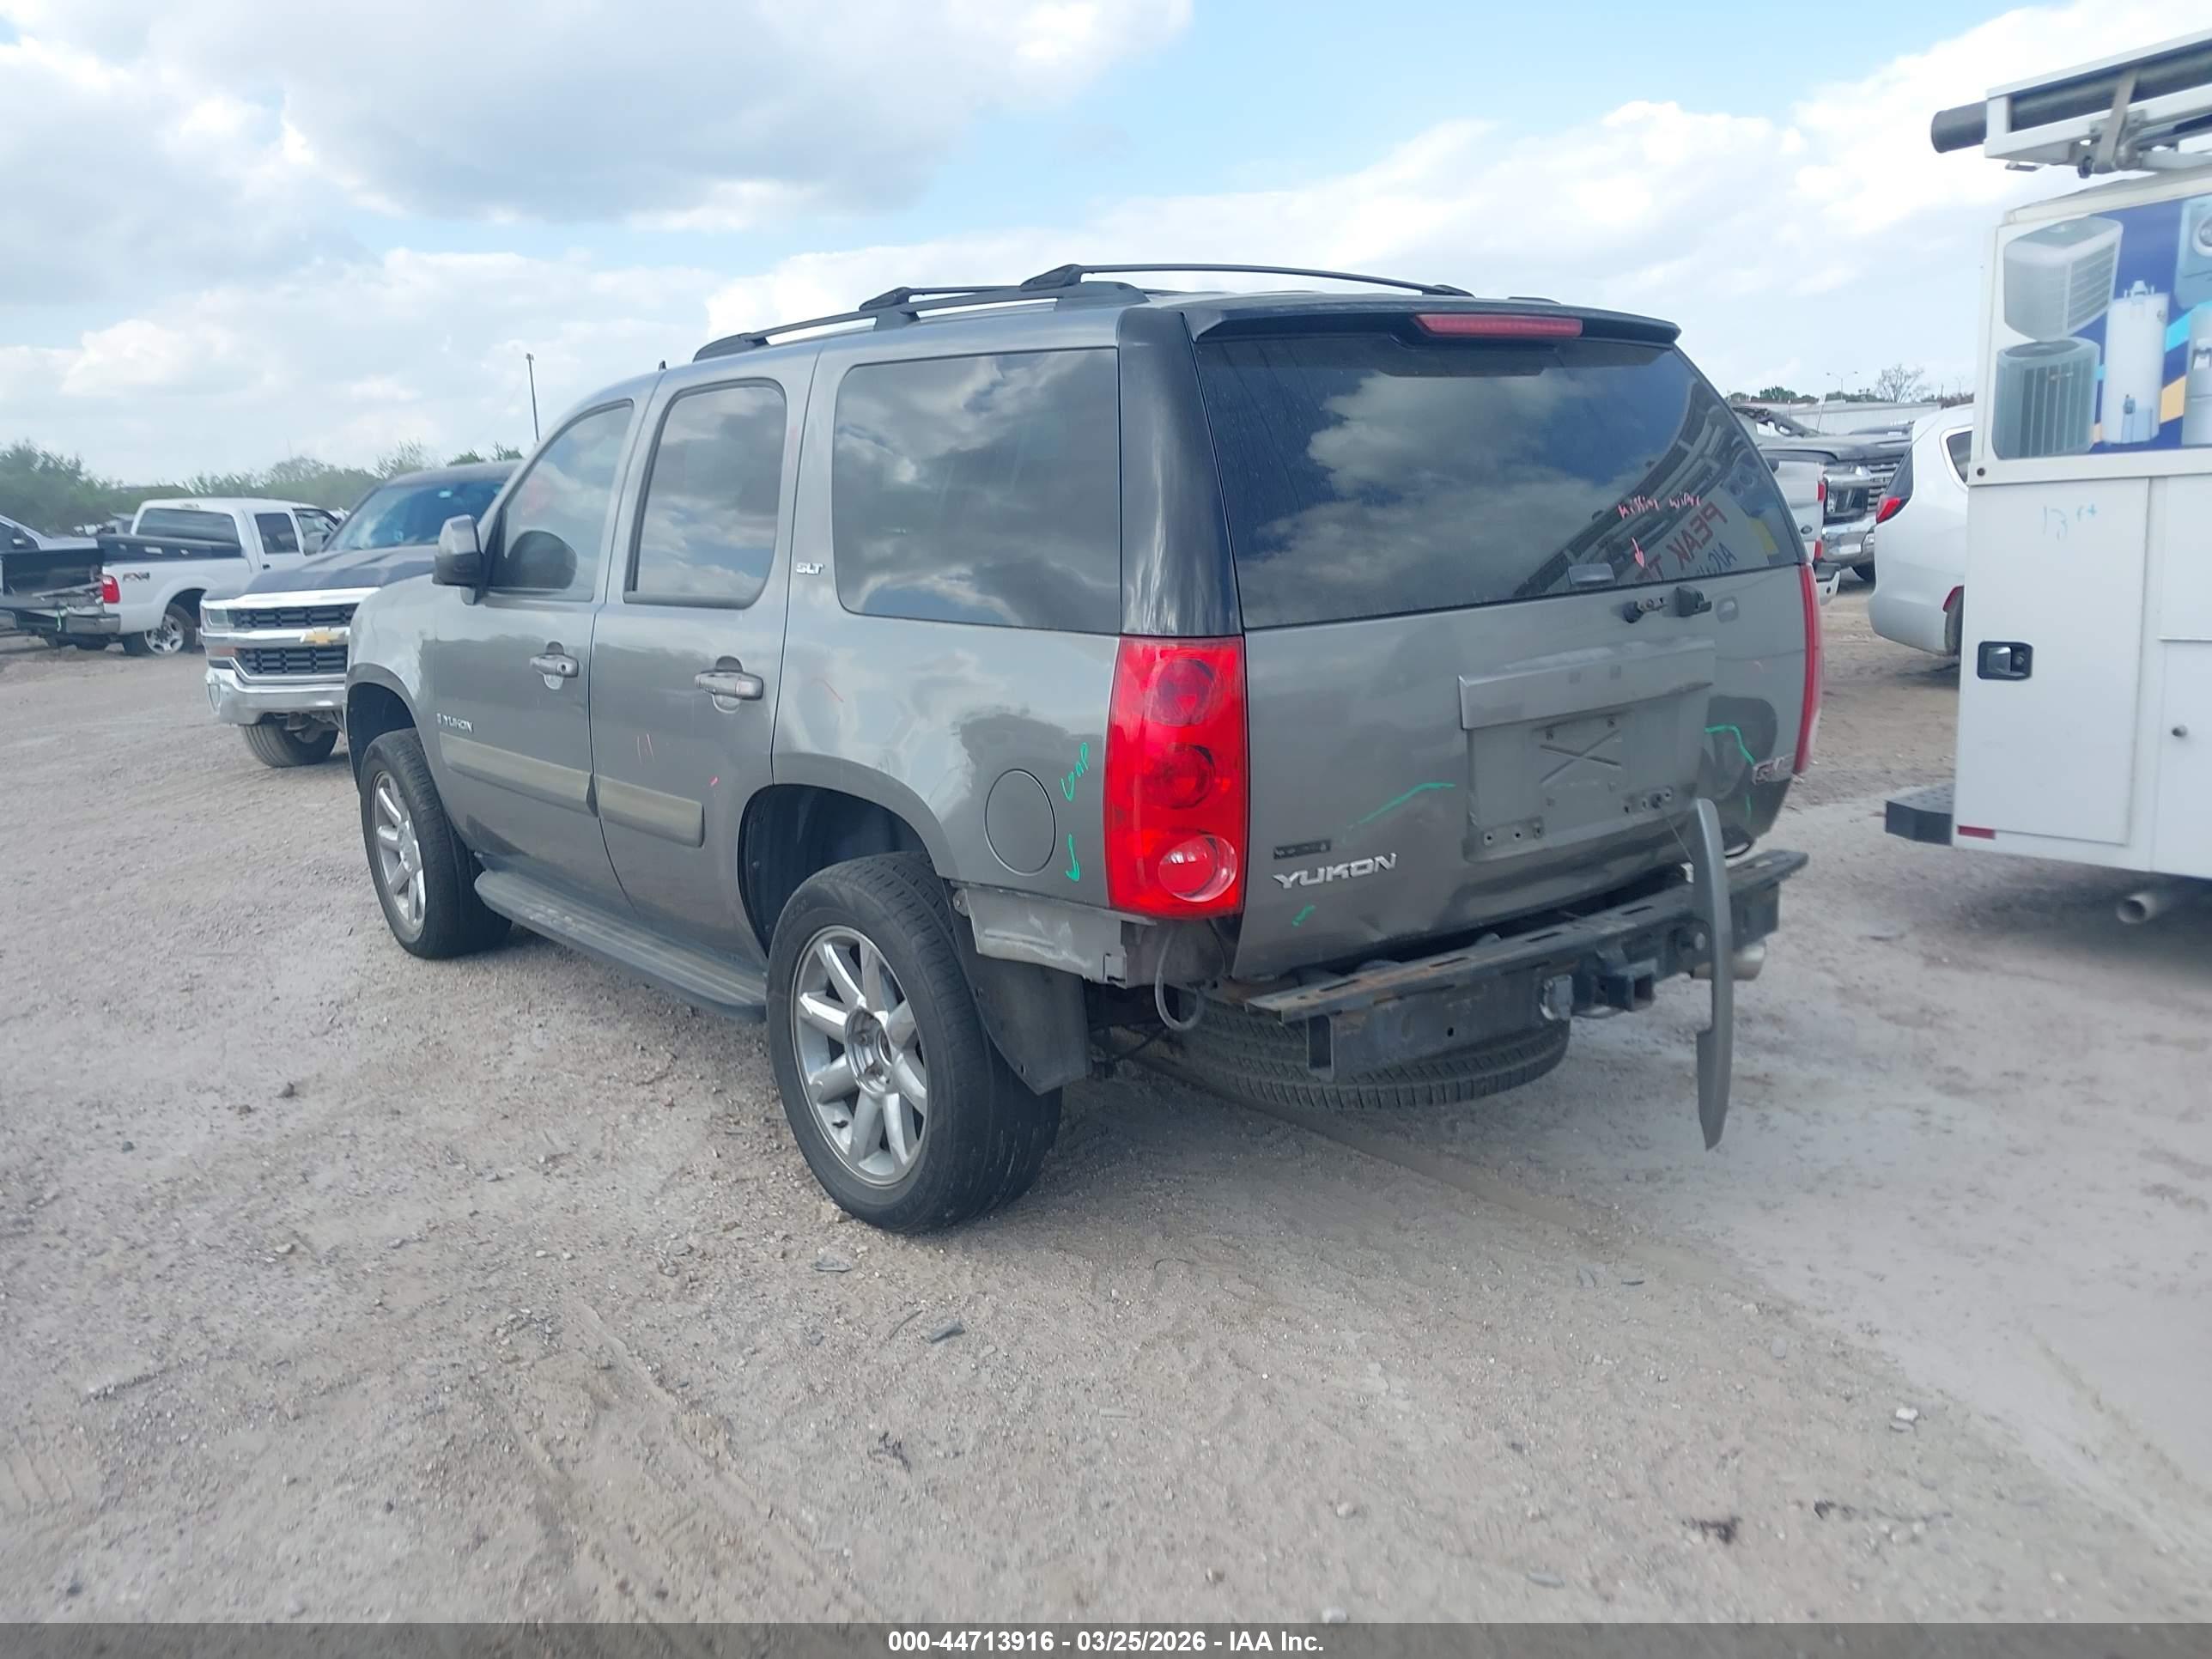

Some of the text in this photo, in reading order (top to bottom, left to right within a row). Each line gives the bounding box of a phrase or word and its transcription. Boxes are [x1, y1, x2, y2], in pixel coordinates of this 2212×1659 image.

[796, 562, 825, 574] SLT
[442, 714, 473, 733] YUKON
[1273, 852, 1397, 890] YUKON
